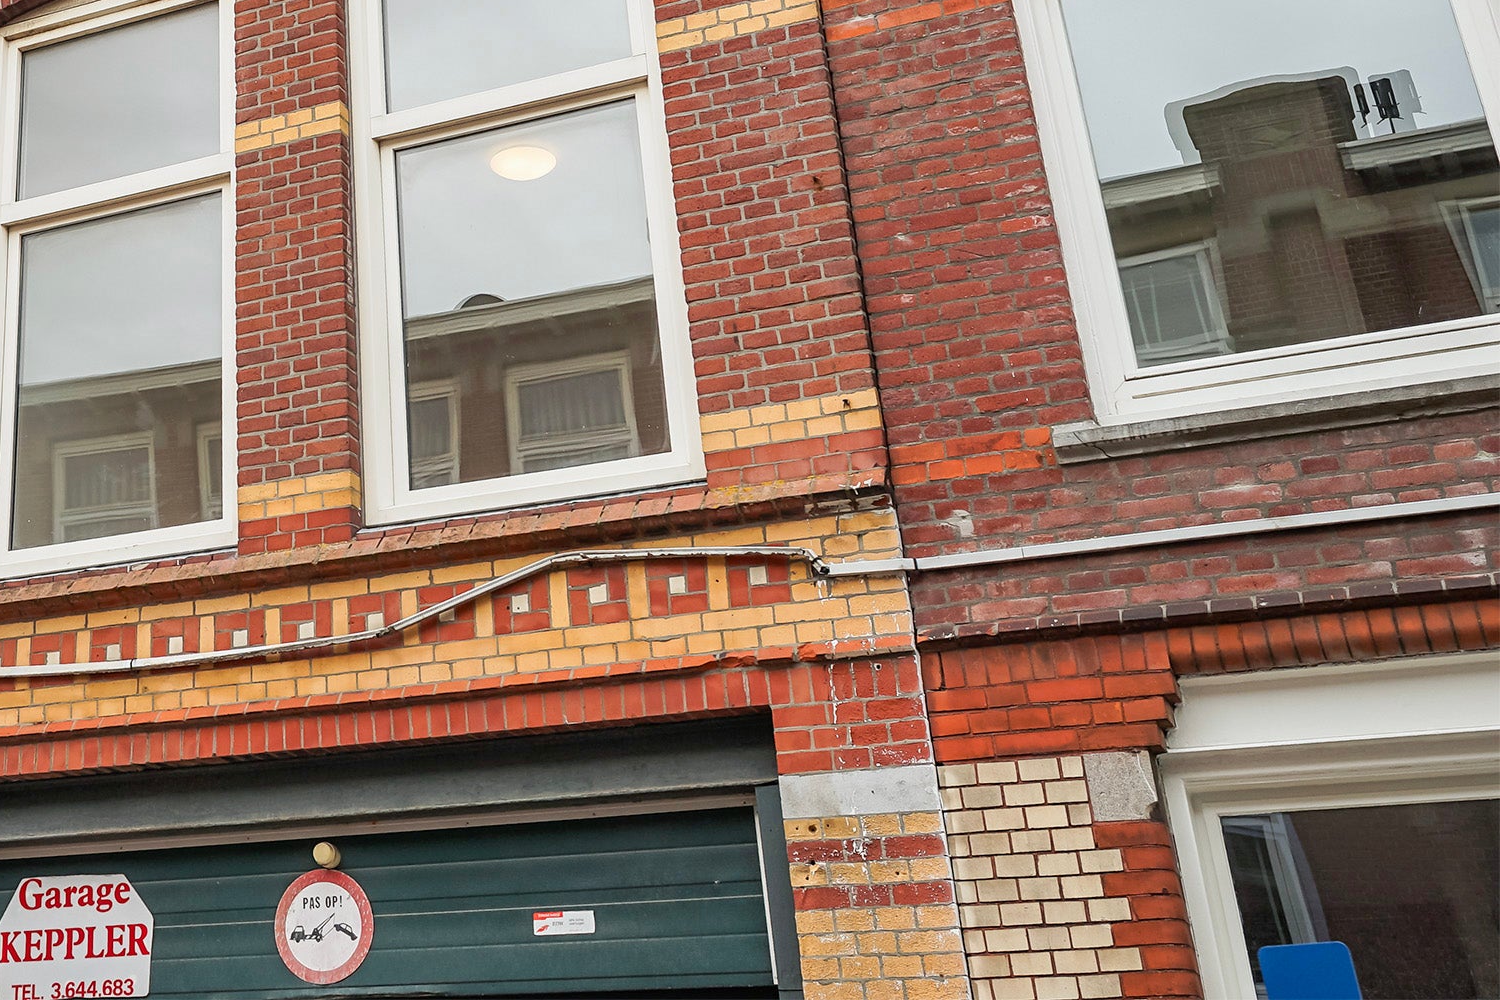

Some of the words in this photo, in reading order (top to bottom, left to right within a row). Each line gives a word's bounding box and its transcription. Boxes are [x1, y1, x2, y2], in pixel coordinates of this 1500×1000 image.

[18, 878, 131, 913] Garage
[302, 896, 321, 910] PAS
[325, 895, 343, 909] OP!
[0, 923, 150, 963] KEPPLER
[11, 984, 44, 1000] TEL.
[51, 978, 134, 999] 3.644.683
